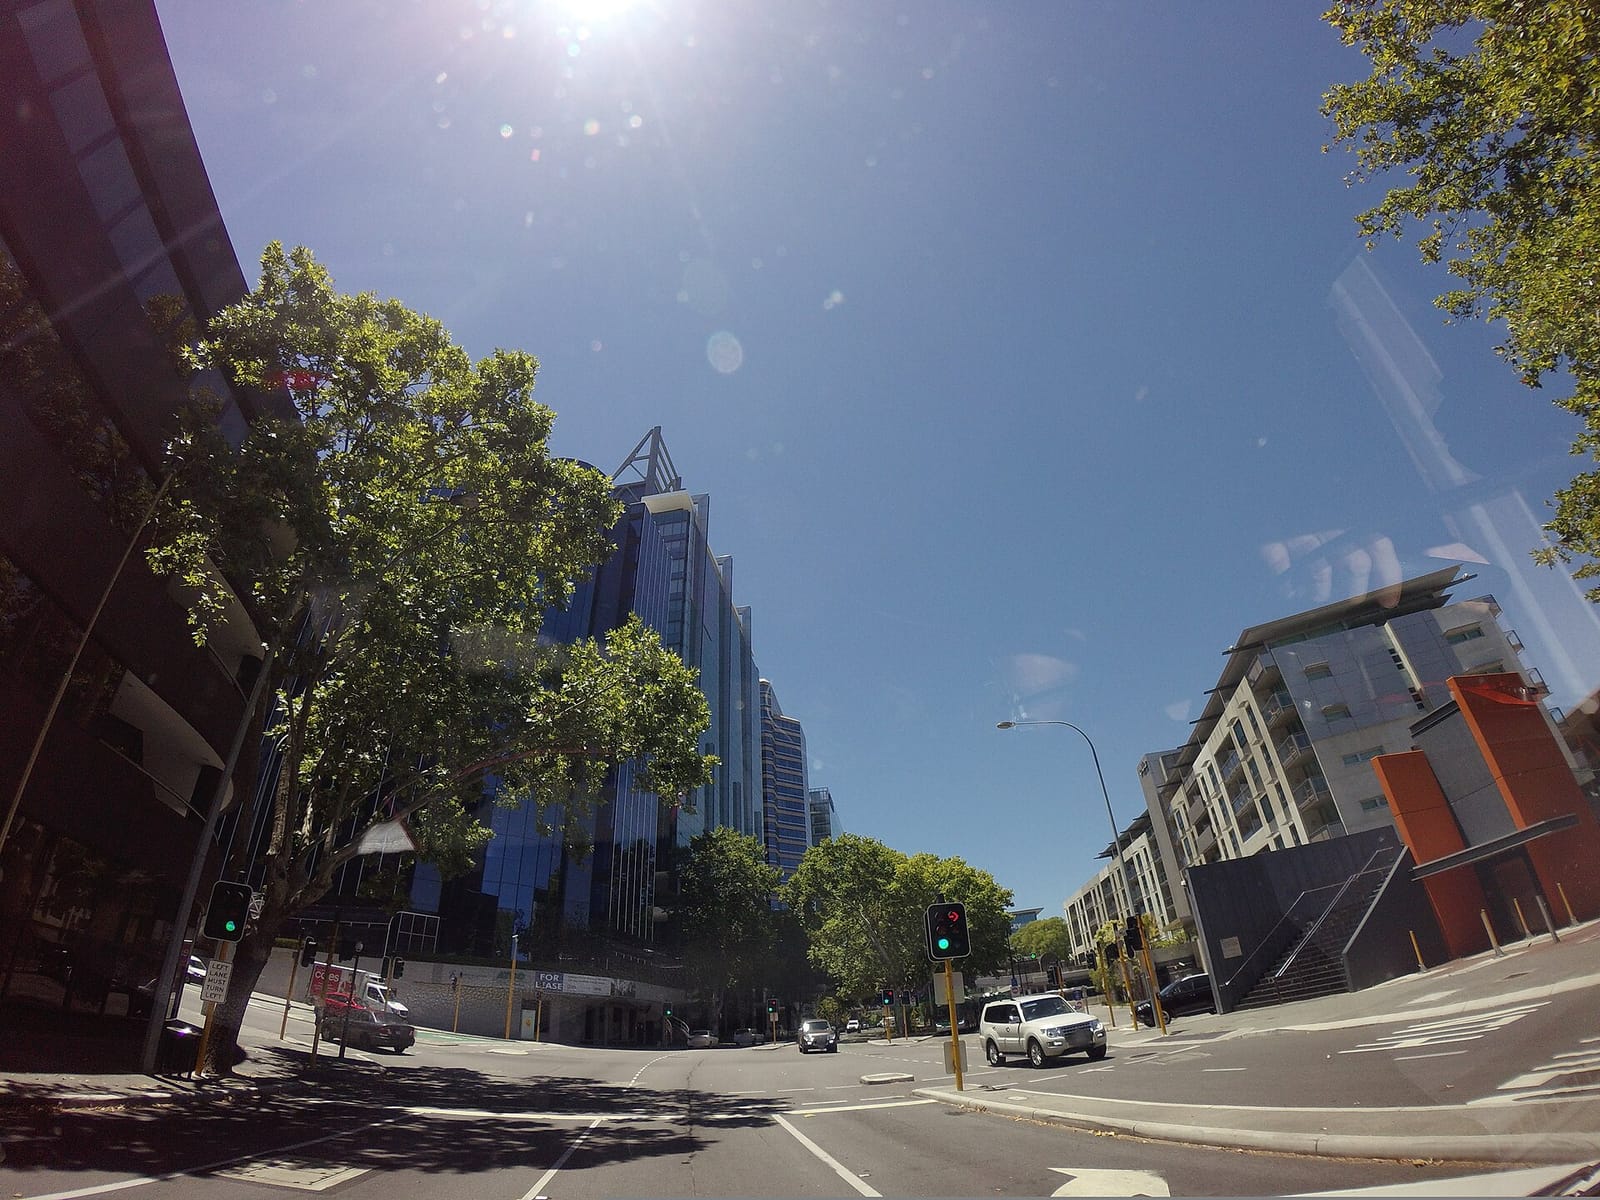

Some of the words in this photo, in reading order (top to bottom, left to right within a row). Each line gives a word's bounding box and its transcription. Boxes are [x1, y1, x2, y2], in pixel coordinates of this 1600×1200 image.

[211, 963, 230, 971] LEFT
[209, 971, 228, 979] LANE
[315, 971, 340, 982] coes
[540, 973, 560, 981] FOR
[208, 977, 226, 985] MUST
[206, 985, 225, 993] TURN
[205, 992, 223, 1000] LEFT
